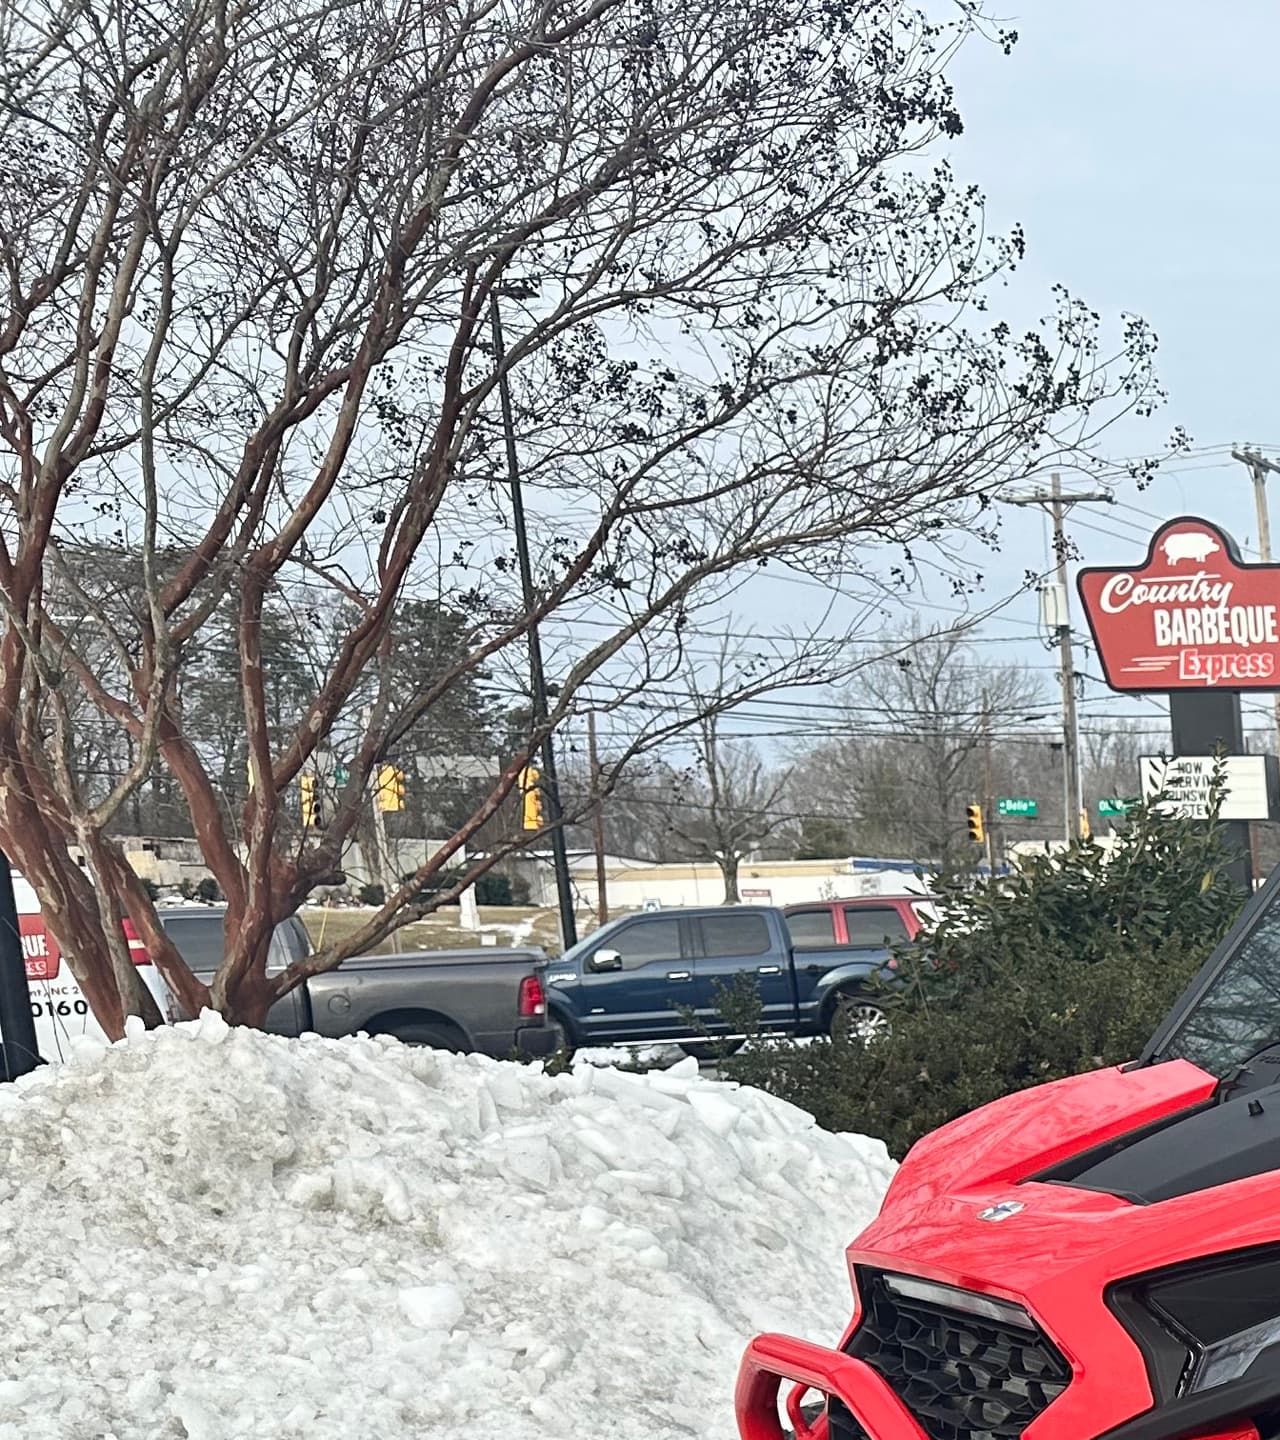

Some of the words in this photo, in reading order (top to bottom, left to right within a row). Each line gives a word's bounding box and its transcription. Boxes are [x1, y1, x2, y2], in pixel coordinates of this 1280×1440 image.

[1100, 571, 1233, 614] Country
[1154, 605, 1279, 647] BARBEQUE
[1180, 649, 1275, 686] Express
[1178, 762, 1202, 774] NOW
[1182, 804, 1209, 816] STE
